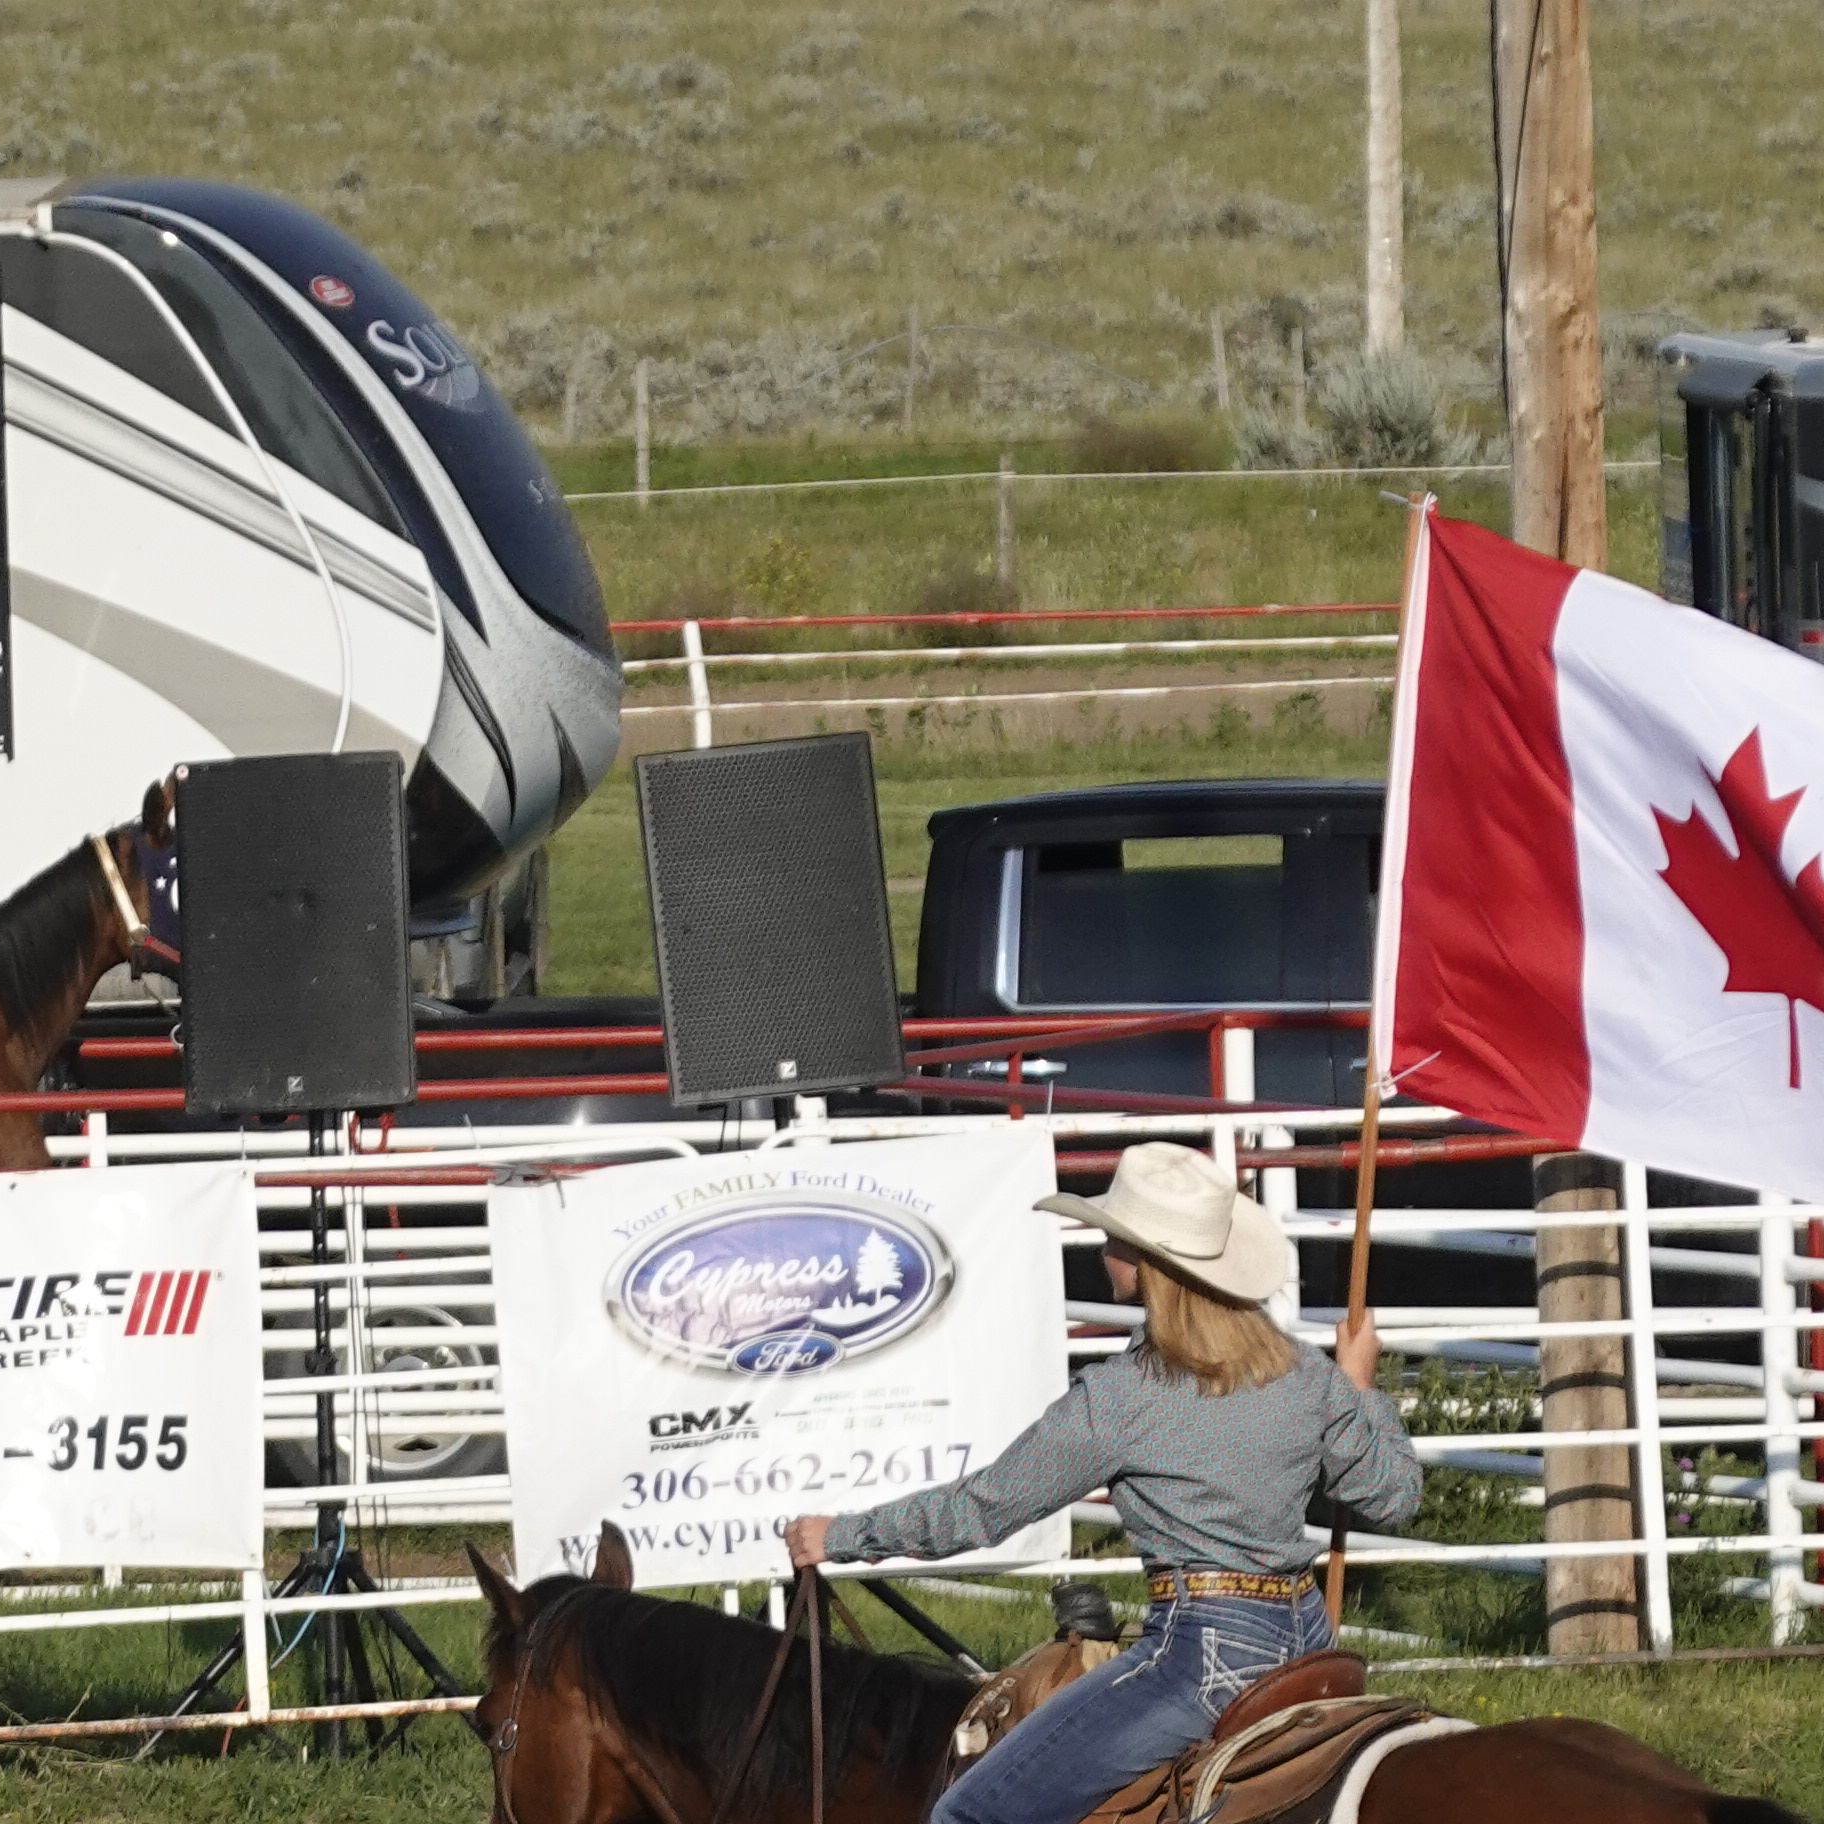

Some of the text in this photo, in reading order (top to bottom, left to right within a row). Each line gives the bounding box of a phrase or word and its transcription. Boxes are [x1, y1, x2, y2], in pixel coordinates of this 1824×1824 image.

[612, 1169, 937, 1242] Your FAMILY Ford Dealer
[648, 1249, 850, 1306] Cypress
[738, 1291, 814, 1315] Motors
[753, 1339, 819, 1373] Ford
[620, 1441, 975, 1511] 306-662-2617
